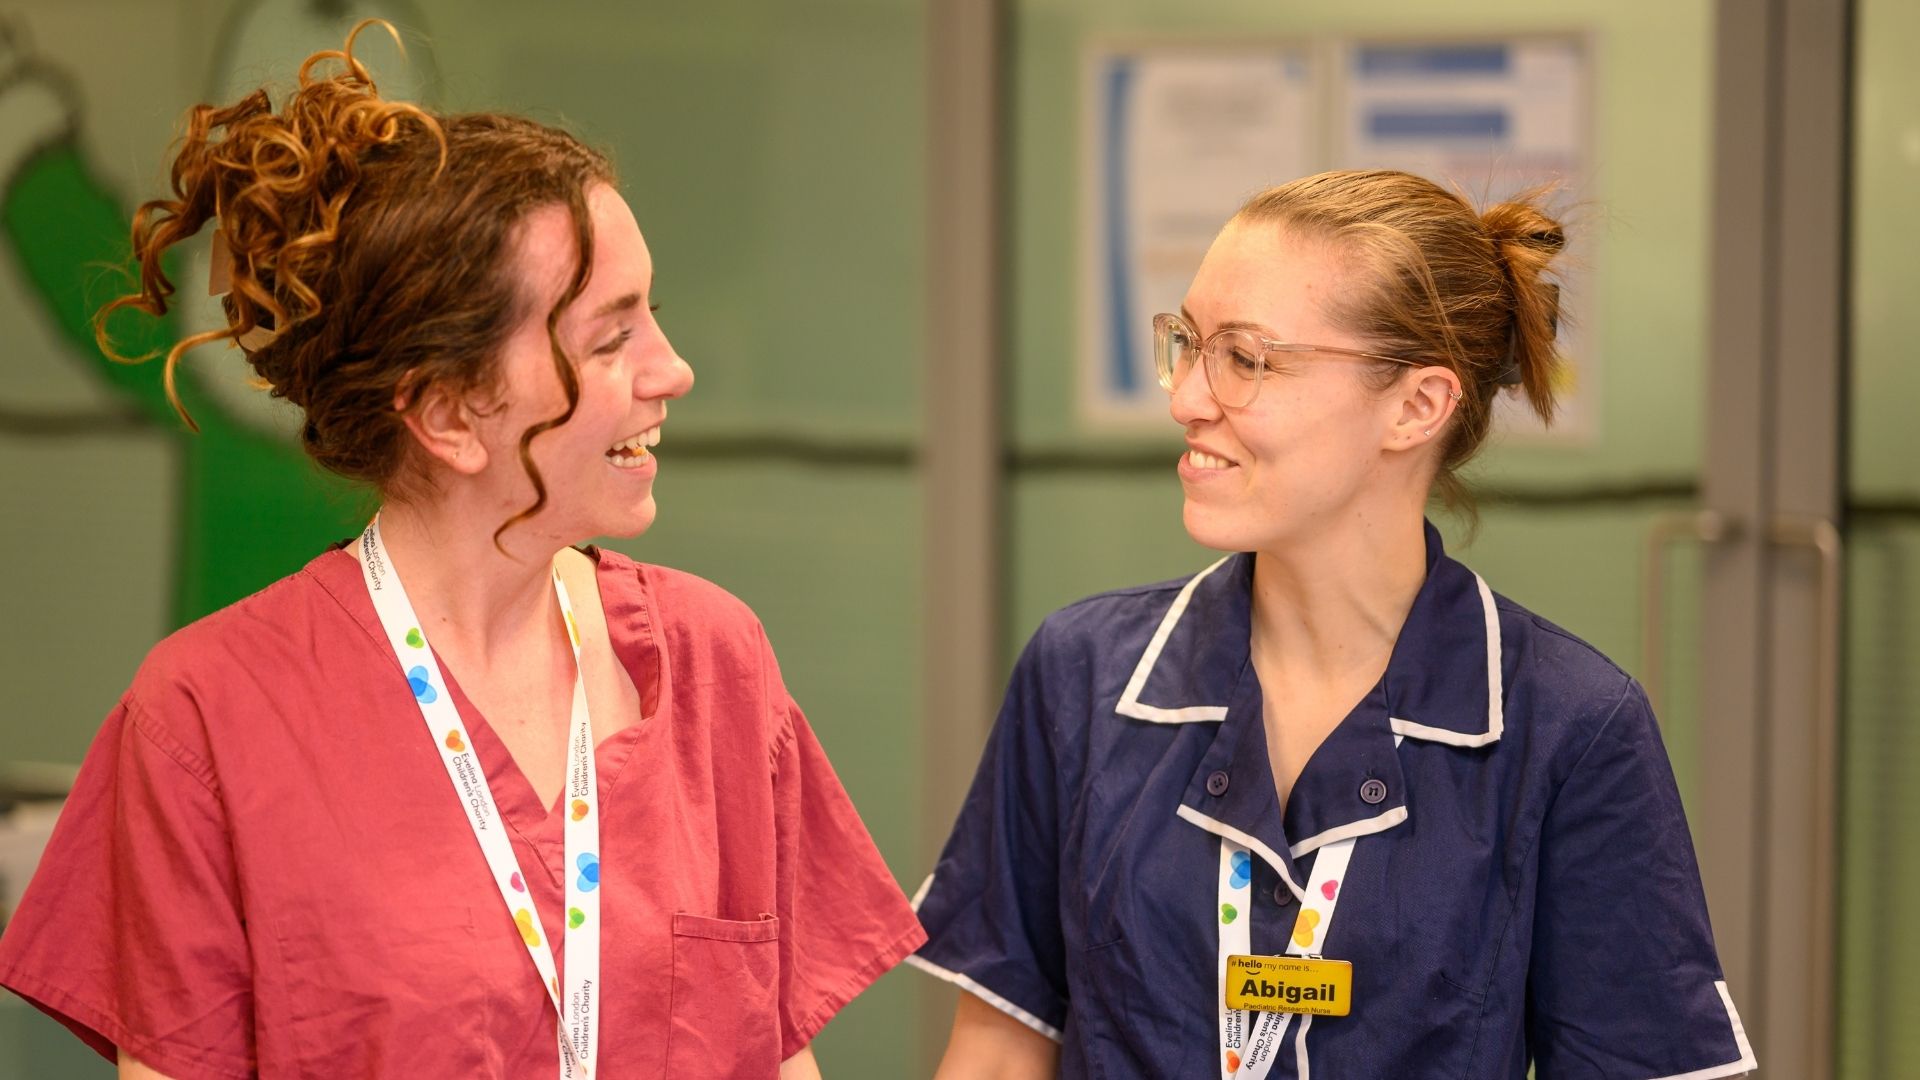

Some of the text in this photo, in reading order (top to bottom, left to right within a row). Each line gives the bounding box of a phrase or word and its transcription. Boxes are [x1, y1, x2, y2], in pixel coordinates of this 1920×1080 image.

[368, 561, 382, 591] Charity
[373, 547, 386, 576] London
[461, 752, 490, 817] Evelina London
[572, 767, 580, 798] Evelina
[580, 755, 589, 796] Children's
[452, 756, 487, 830] Children's Charity
[1264, 963, 1277, 971] my
[1240, 979, 1335, 1004] Abigail
[571, 992, 580, 1053] elina London
[580, 979, 592, 1060] Children's Charity
[1243, 1003, 1278, 1011] Paediatric
[1278, 1004, 1310, 1013] Research
[1225, 1017, 1233, 1048] Evelina
[1259, 1031, 1278, 1062] London
[1245, 1038, 1265, 1071] Charity
